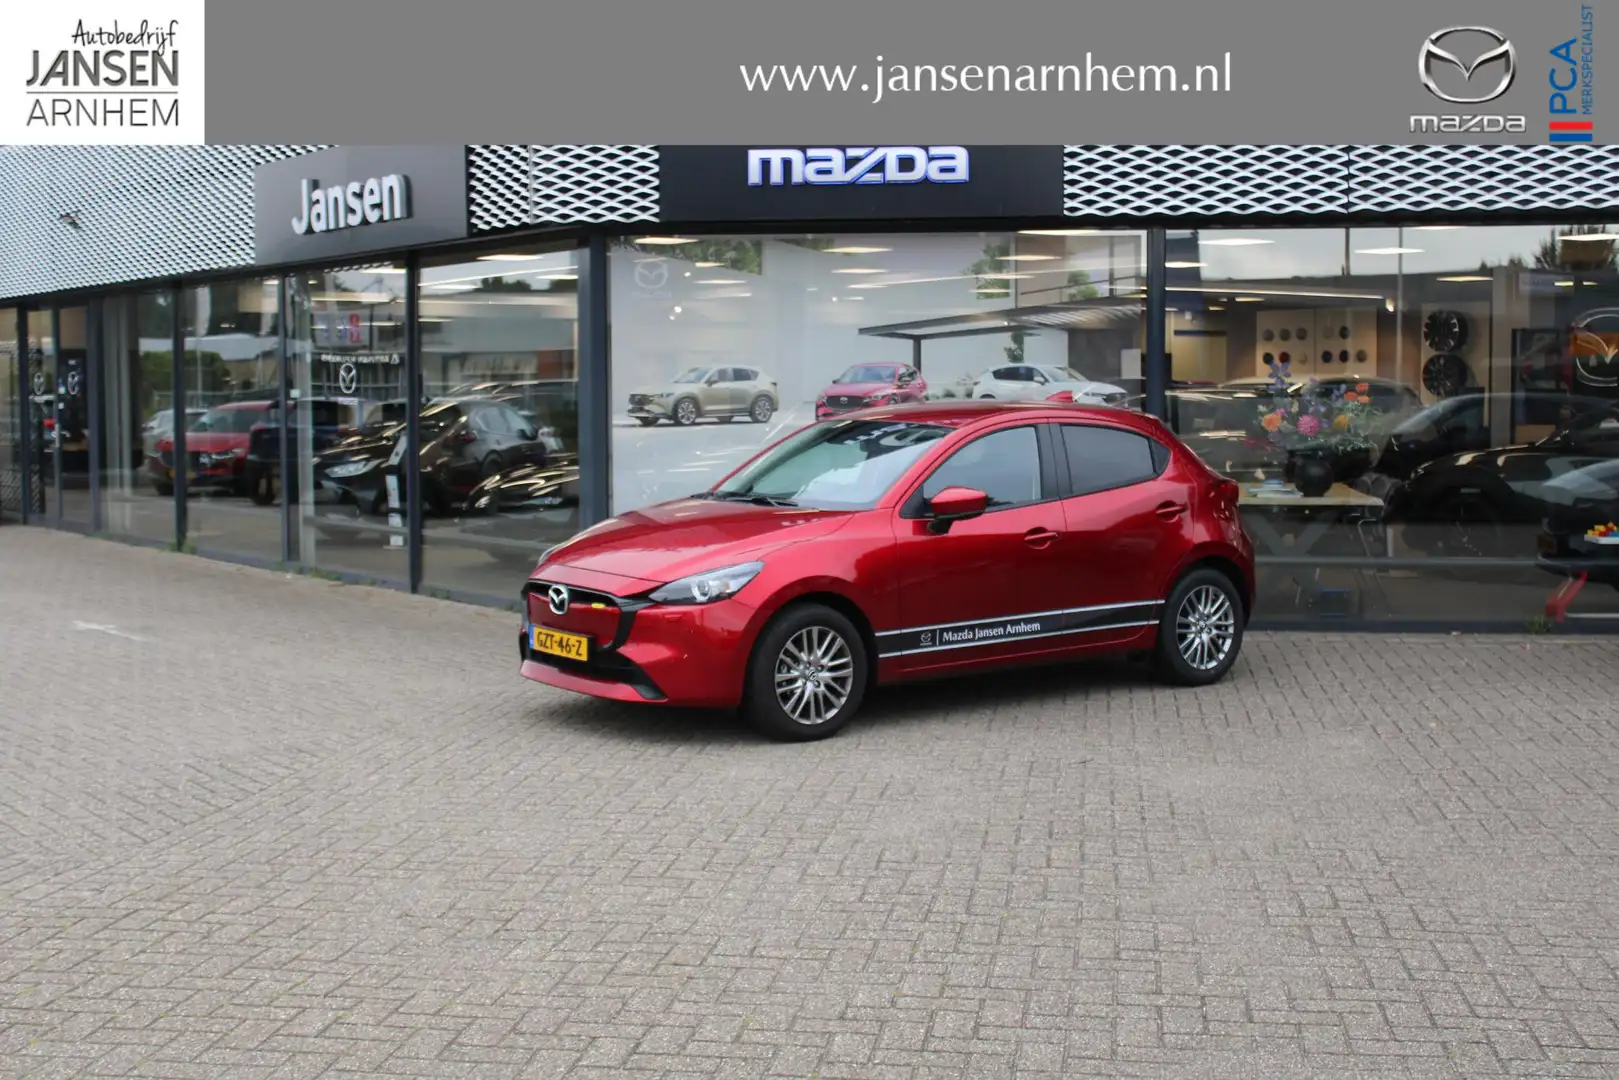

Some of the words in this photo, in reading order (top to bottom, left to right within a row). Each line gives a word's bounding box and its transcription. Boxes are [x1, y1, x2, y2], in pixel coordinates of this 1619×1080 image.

[748, 146, 969, 186] mazda
[291, 173, 412, 235] Jansen
[536, 631, 583, 657] GZT-46-Z
[942, 628, 974, 642] Mazda
[975, 626, 1004, 640] Jansen
[1006, 622, 1041, 634] Arnhem
